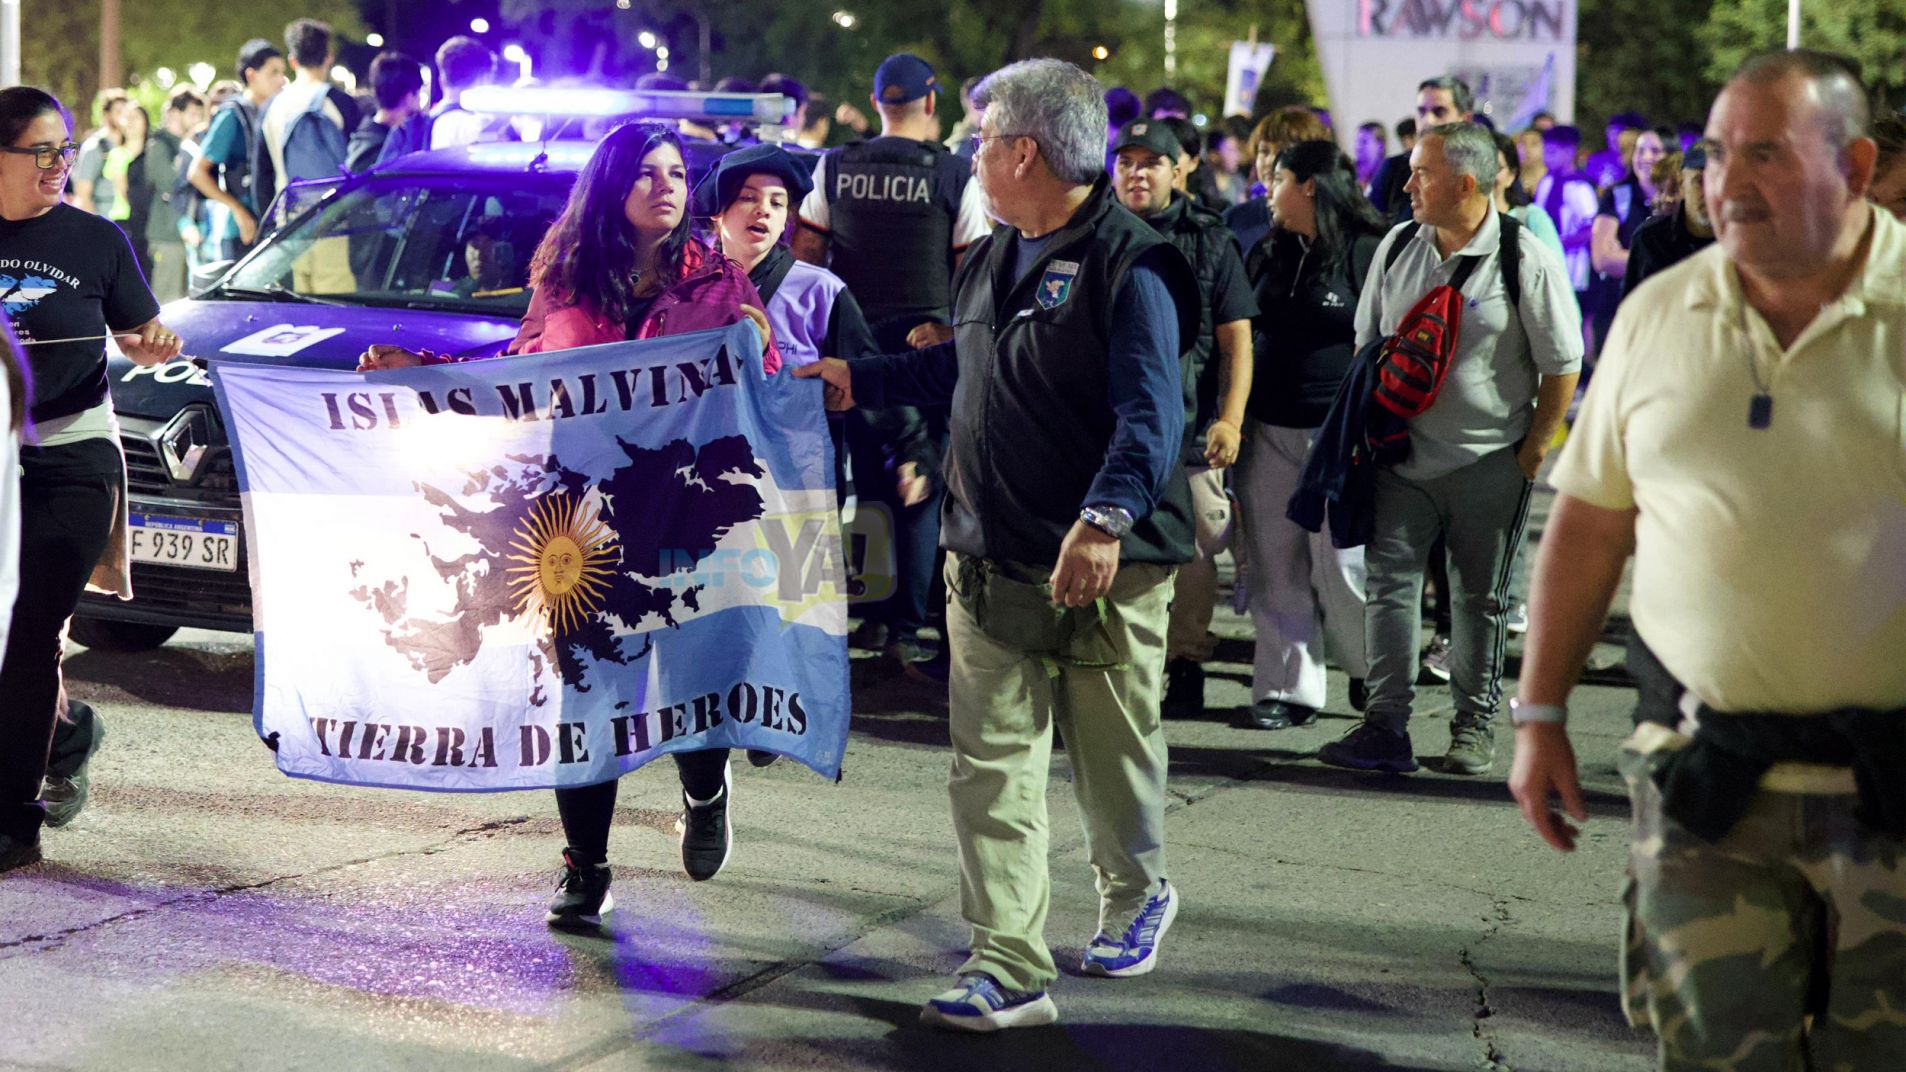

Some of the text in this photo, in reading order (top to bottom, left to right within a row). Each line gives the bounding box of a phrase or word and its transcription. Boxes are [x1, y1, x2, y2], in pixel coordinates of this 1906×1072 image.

[1357, 0, 1564, 40] RAWSON
[837, 173, 930, 204] POLICIA
[24, 260, 80, 289] OLVIDAR
[495, 344, 744, 423] MALVINA
[153, 532, 193, 561] 939
[202, 537, 229, 565] SR
[309, 681, 807, 768] TIERRA DE HEROES
